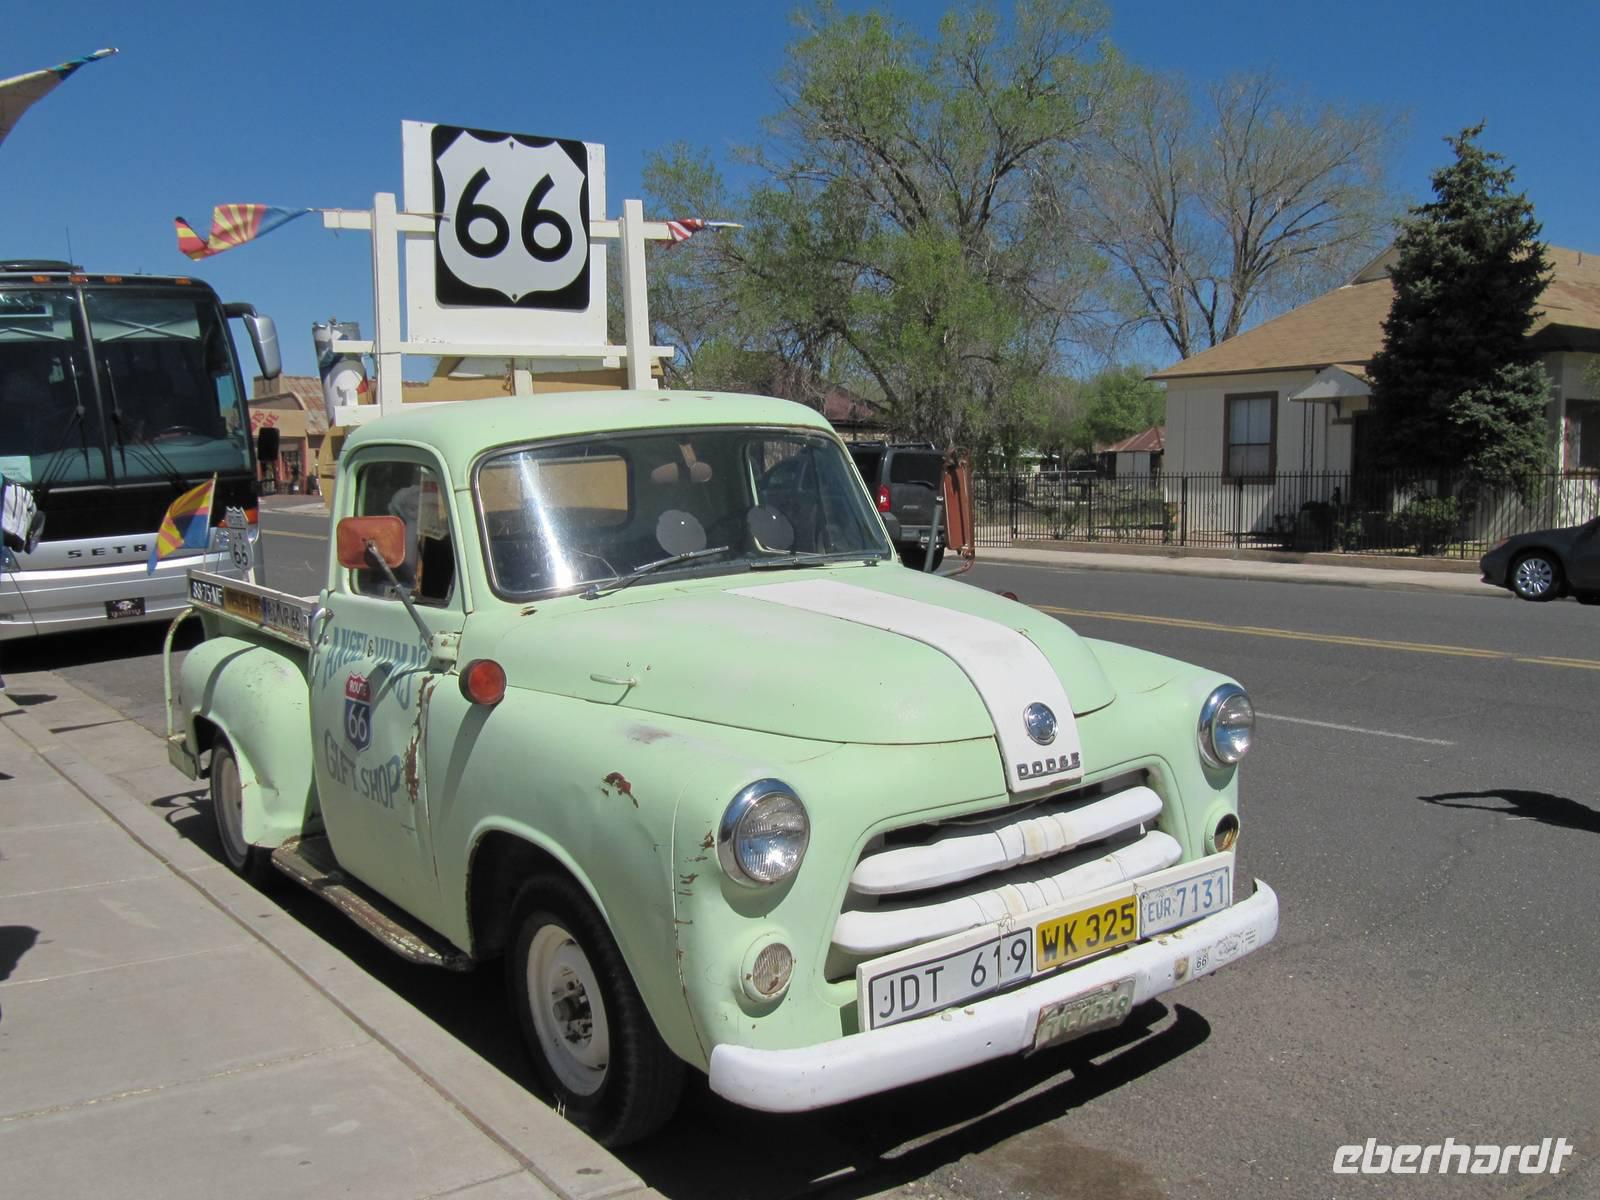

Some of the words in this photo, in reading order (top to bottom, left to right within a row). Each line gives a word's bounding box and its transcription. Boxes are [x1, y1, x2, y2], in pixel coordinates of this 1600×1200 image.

[455, 167, 573, 263] 66
[67, 543, 148, 559] SETR
[367, 639, 374, 657] &
[350, 679, 367, 697] ROUTE
[349, 704, 368, 740] 66
[324, 728, 357, 791] GIFT
[360, 754, 400, 809] SHOP
[1016, 752, 1080, 780] DODGE
[1041, 920, 1078, 962] WK
[1086, 902, 1135, 948] 325
[879, 965, 945, 1018] JDT
